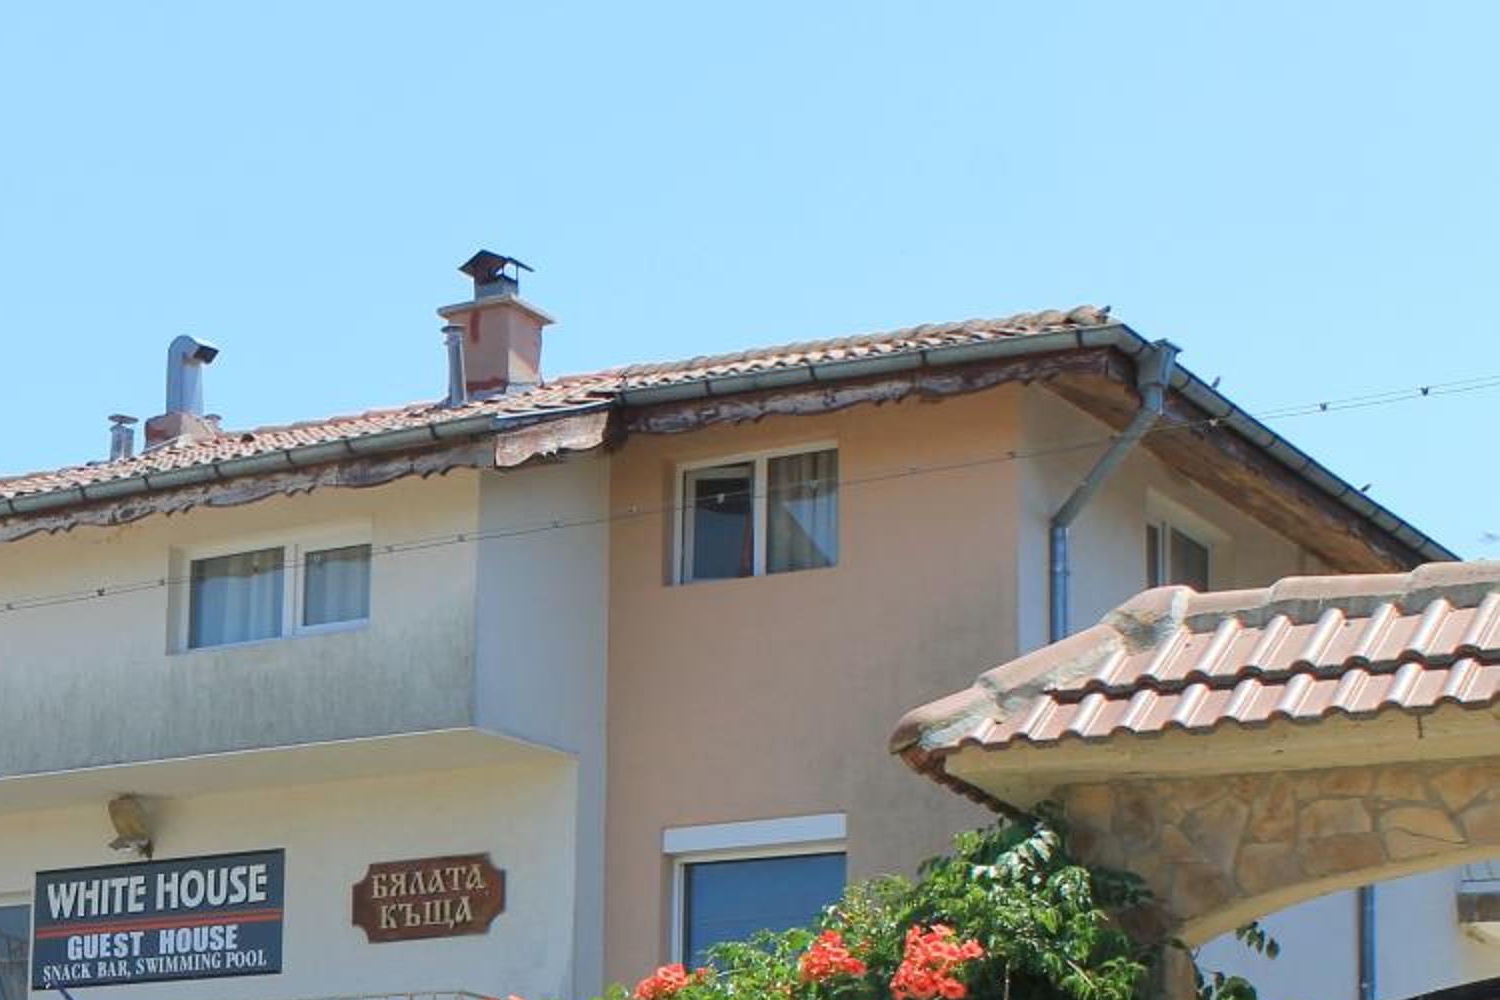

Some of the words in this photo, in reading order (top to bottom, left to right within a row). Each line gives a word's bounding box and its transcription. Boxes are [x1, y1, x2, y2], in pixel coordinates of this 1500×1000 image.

[48, 875, 146, 919] WHITE
[155, 864, 268, 910] HOUSE
[371, 864, 485, 898] БЯЛАТА
[380, 896, 473, 929] КЪЩА
[67, 931, 144, 961] GUEST
[159, 924, 239, 954] HOUSE
[43, 963, 92, 983] SNACK
[98, 960, 131, 978] BAR,
[135, 951, 221, 976] SWIMMING
[225, 949, 267, 968] POOL
